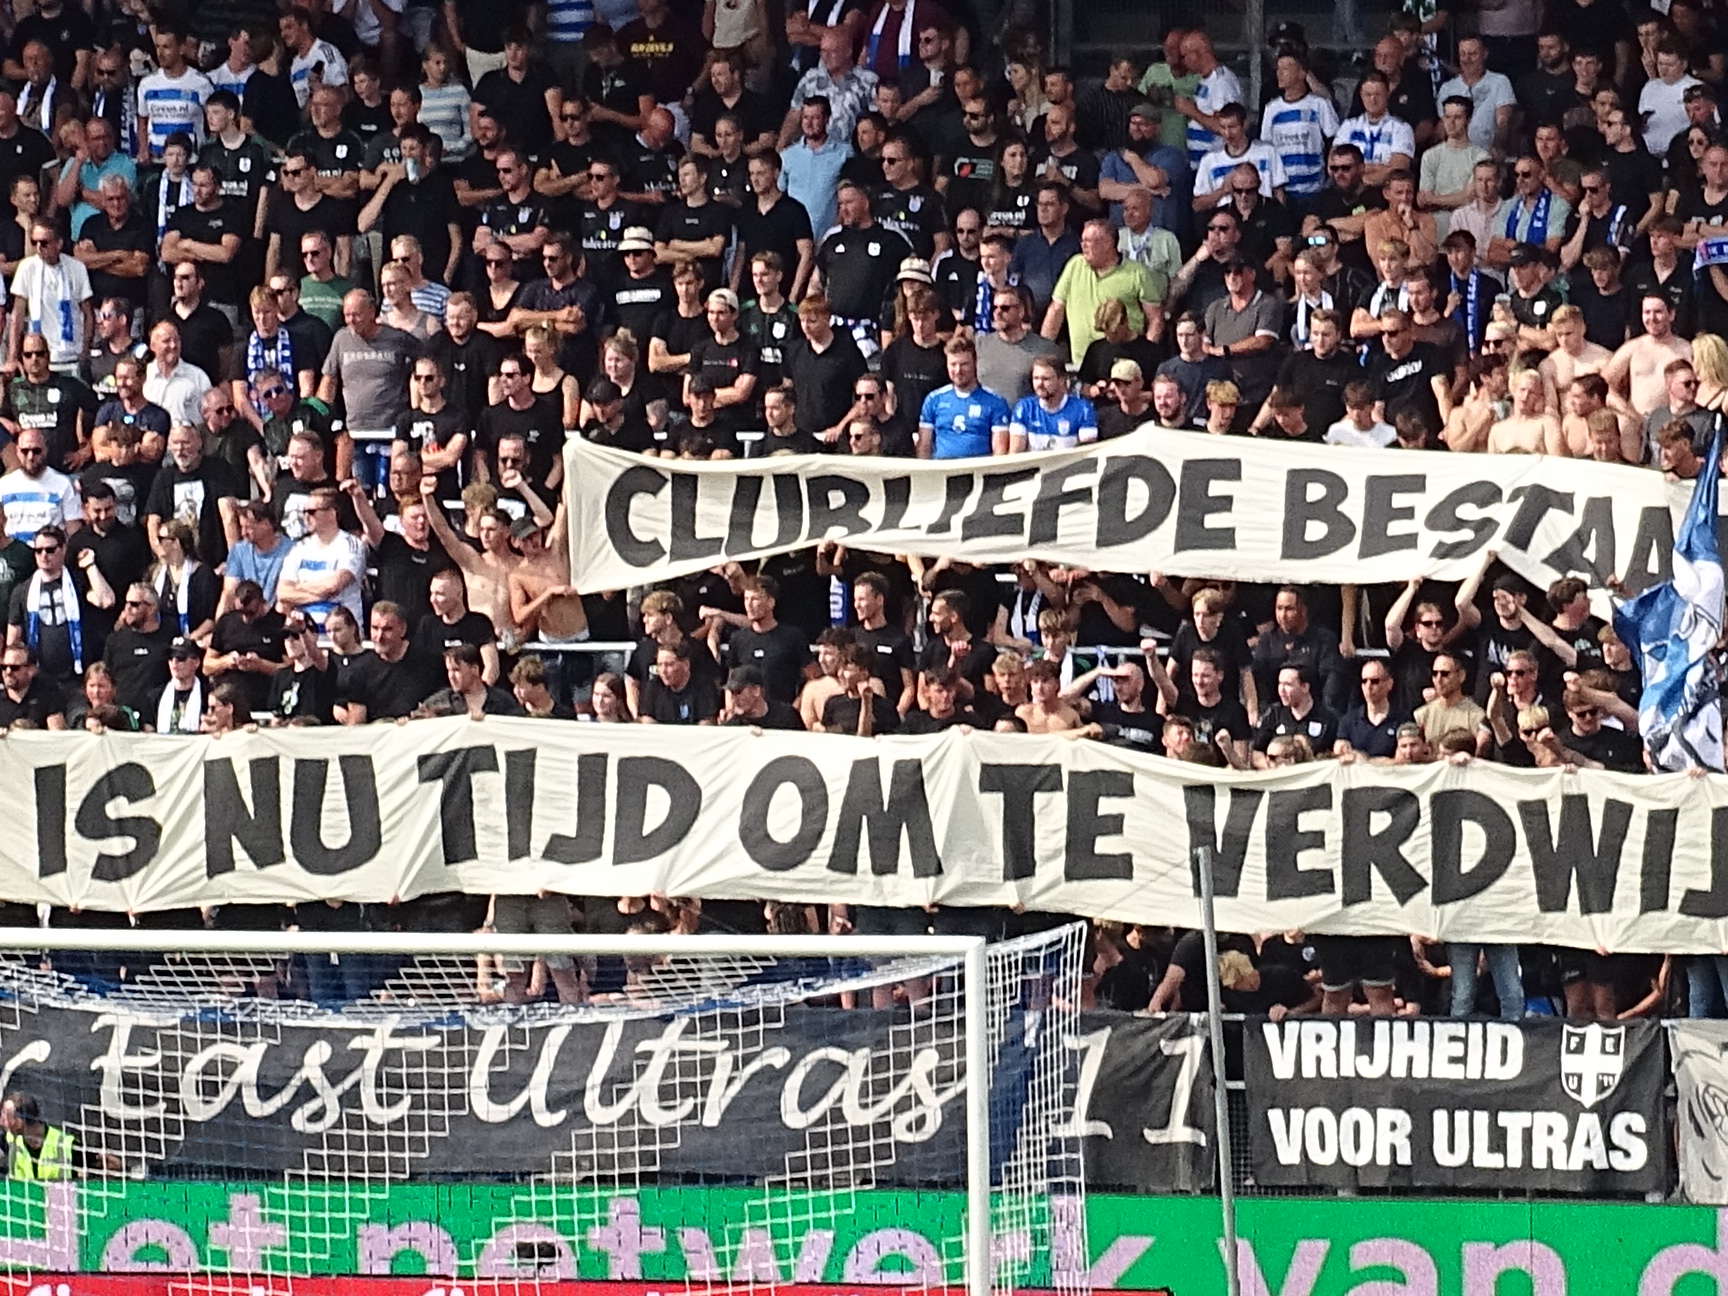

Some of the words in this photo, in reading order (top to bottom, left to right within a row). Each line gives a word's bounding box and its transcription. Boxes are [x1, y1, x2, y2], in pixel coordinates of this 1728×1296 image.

[604, 453, 1243, 568] CLUBLIEFDE
[34, 761, 162, 881] IS
[203, 754, 383, 878] NU
[417, 744, 702, 867] TIJD
[738, 754, 943, 878] OM
[978, 762, 1136, 882] TE
[89, 1012, 442, 1134] East
[470, 1016, 969, 1144] Ultras
[1262, 1021, 1525, 1082] VRIJHEID
[1268, 1107, 1414, 1168] VOOR
[1430, 1107, 1649, 1173] ULTRAS
